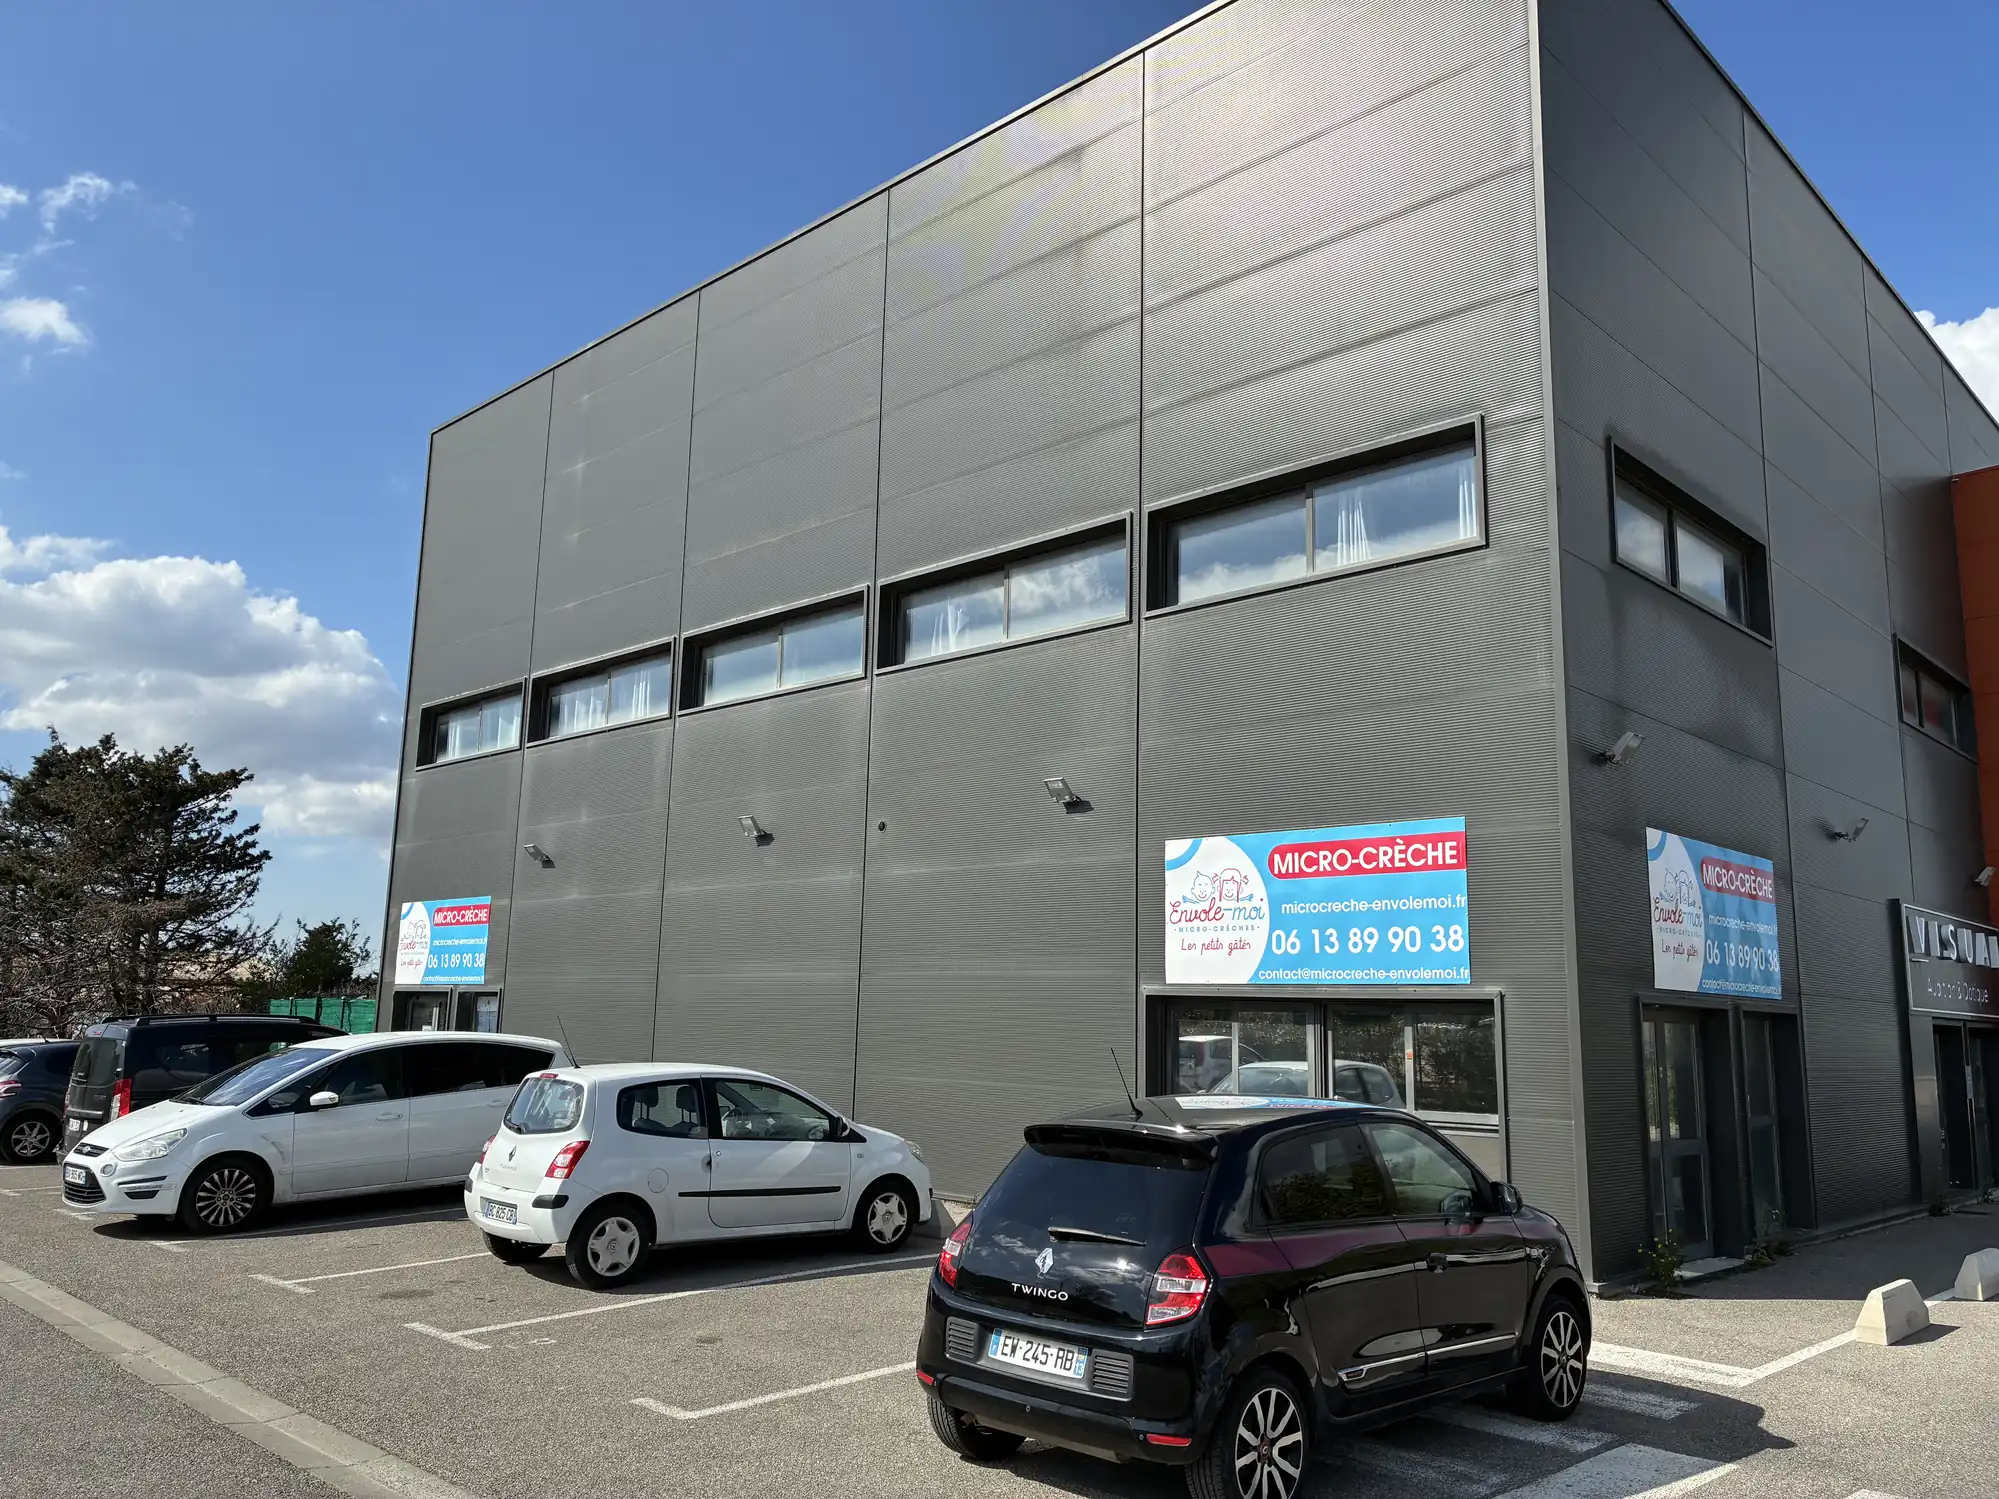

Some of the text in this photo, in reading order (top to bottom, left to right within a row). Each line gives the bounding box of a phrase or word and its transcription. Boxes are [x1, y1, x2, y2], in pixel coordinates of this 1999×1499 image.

[1273, 838, 1458, 875] MICRO-CRÈCHE
[1702, 863, 1773, 899] MICRO-CRÈCHE
[1281, 894, 1467, 914] microcreche-envolemoi.fr
[433, 906, 488, 924] MICRO-CRÈCHE
[1181, 938, 1197, 951] Les
[1201, 937, 1223, 955] petits
[1271, 924, 1465, 955] 06 13 89 90 38
[428, 954, 438, 968] 06
[441, 954, 449, 968] 13
[450, 954, 460, 968] 89
[462, 953, 472, 968] 90
[473, 952, 485, 968] 38
[1706, 939, 1780, 973] 06 13 89 90 38
[1258, 966, 1470, 980] contact@microcreche-envolemoi.fr
[1011, 1282, 1068, 1301] TWINGO
